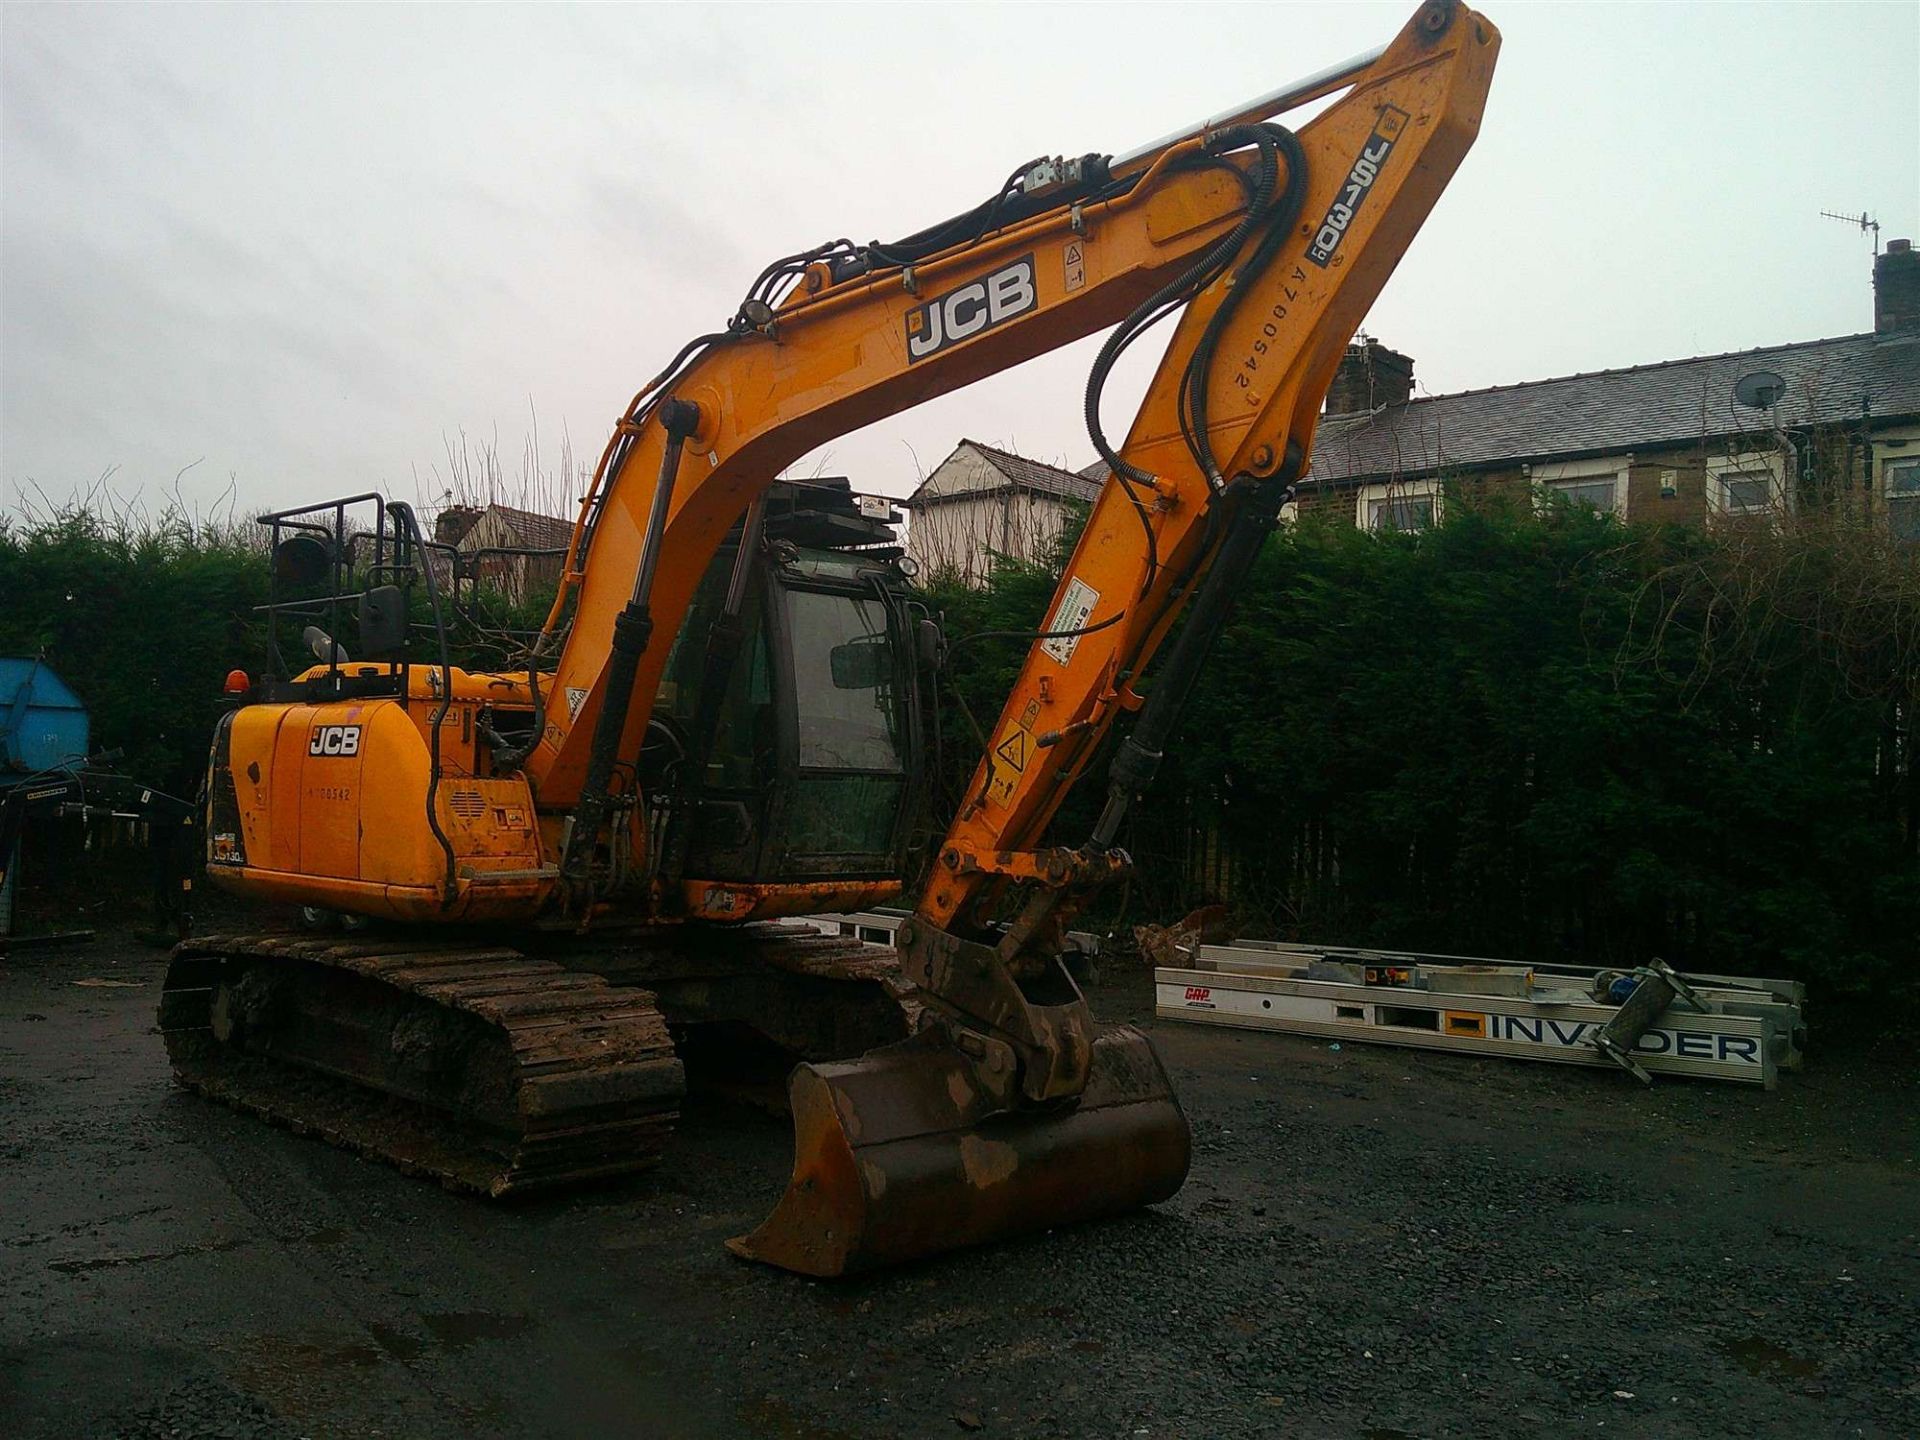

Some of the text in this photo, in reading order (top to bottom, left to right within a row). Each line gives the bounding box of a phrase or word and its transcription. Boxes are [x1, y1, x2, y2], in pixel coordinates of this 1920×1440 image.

[910, 261, 1034, 357] JCB
[310, 726, 361, 755] JCB
[1491, 1015, 1760, 1064] INVDER
